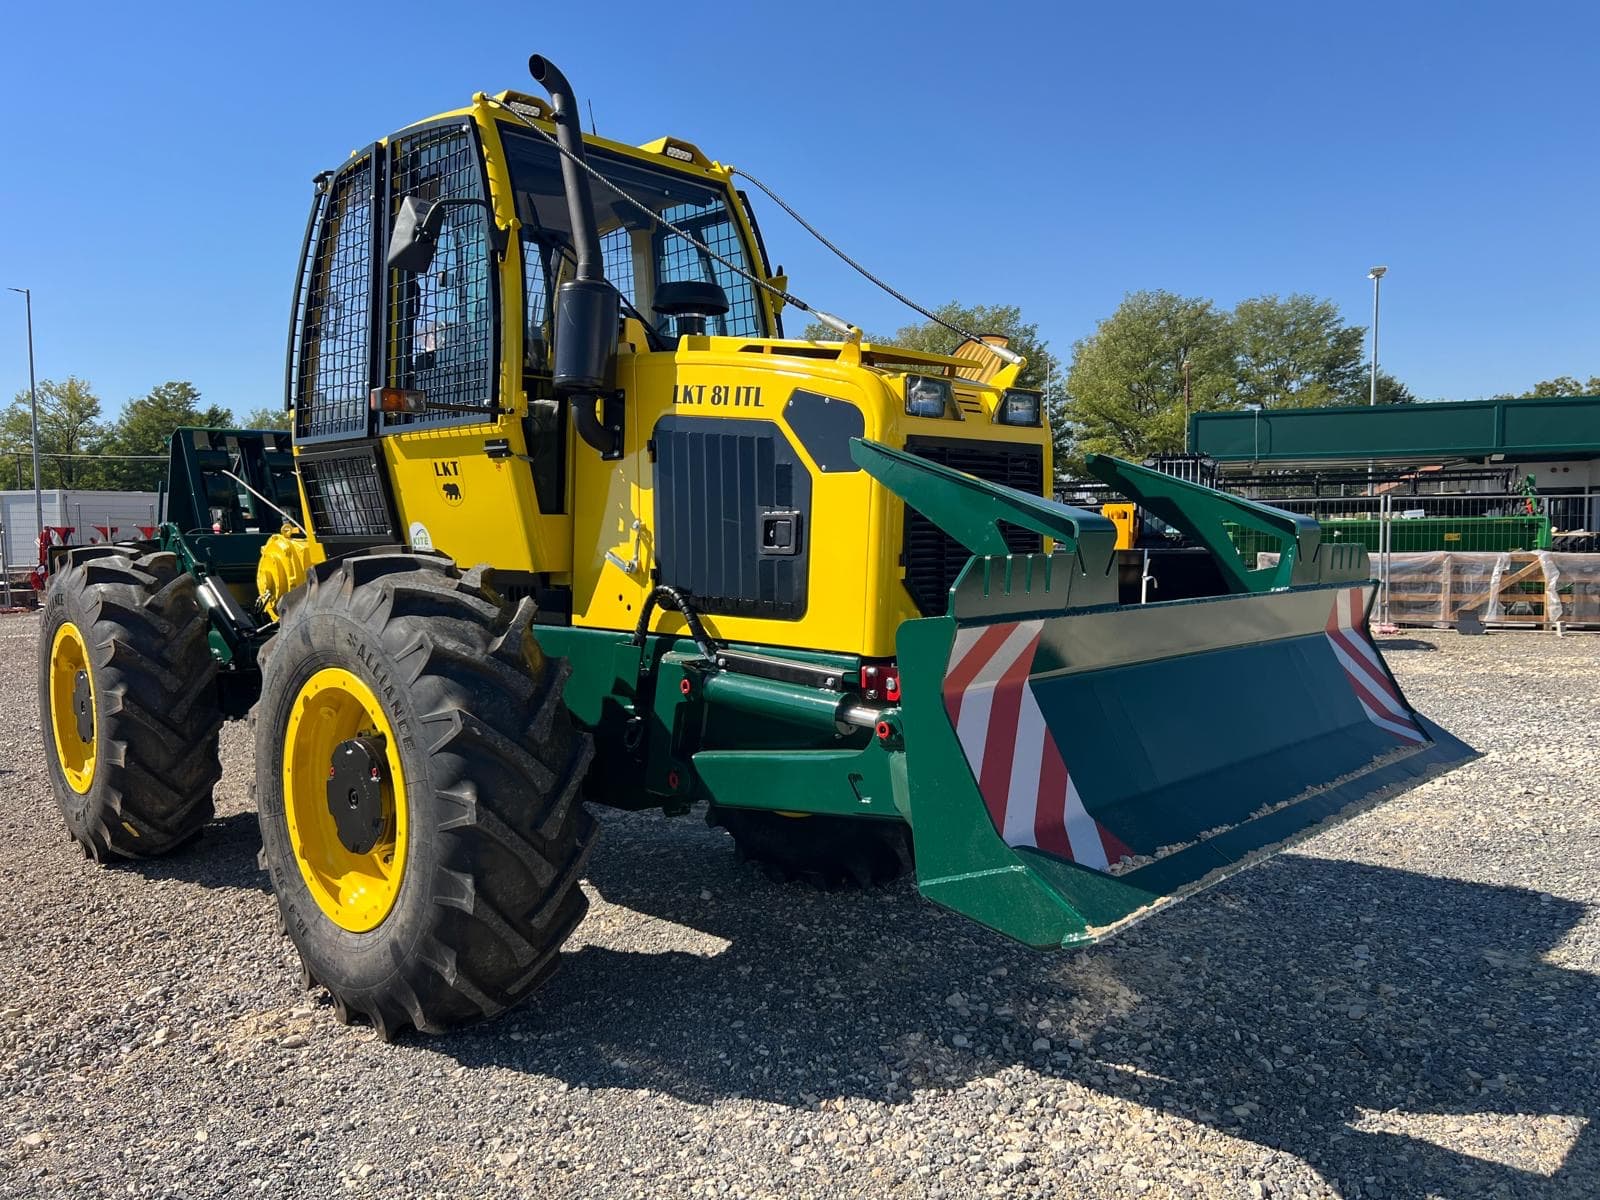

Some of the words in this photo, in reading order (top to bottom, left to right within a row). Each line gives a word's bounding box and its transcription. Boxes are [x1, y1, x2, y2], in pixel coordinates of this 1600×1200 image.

[672, 384, 707, 405] LKT
[710, 385, 730, 406] 81
[734, 386, 765, 407] ITL
[434, 461, 459, 477] LKT
[412, 536, 429, 546] KITE
[356, 643, 416, 753] ALLIANCE
